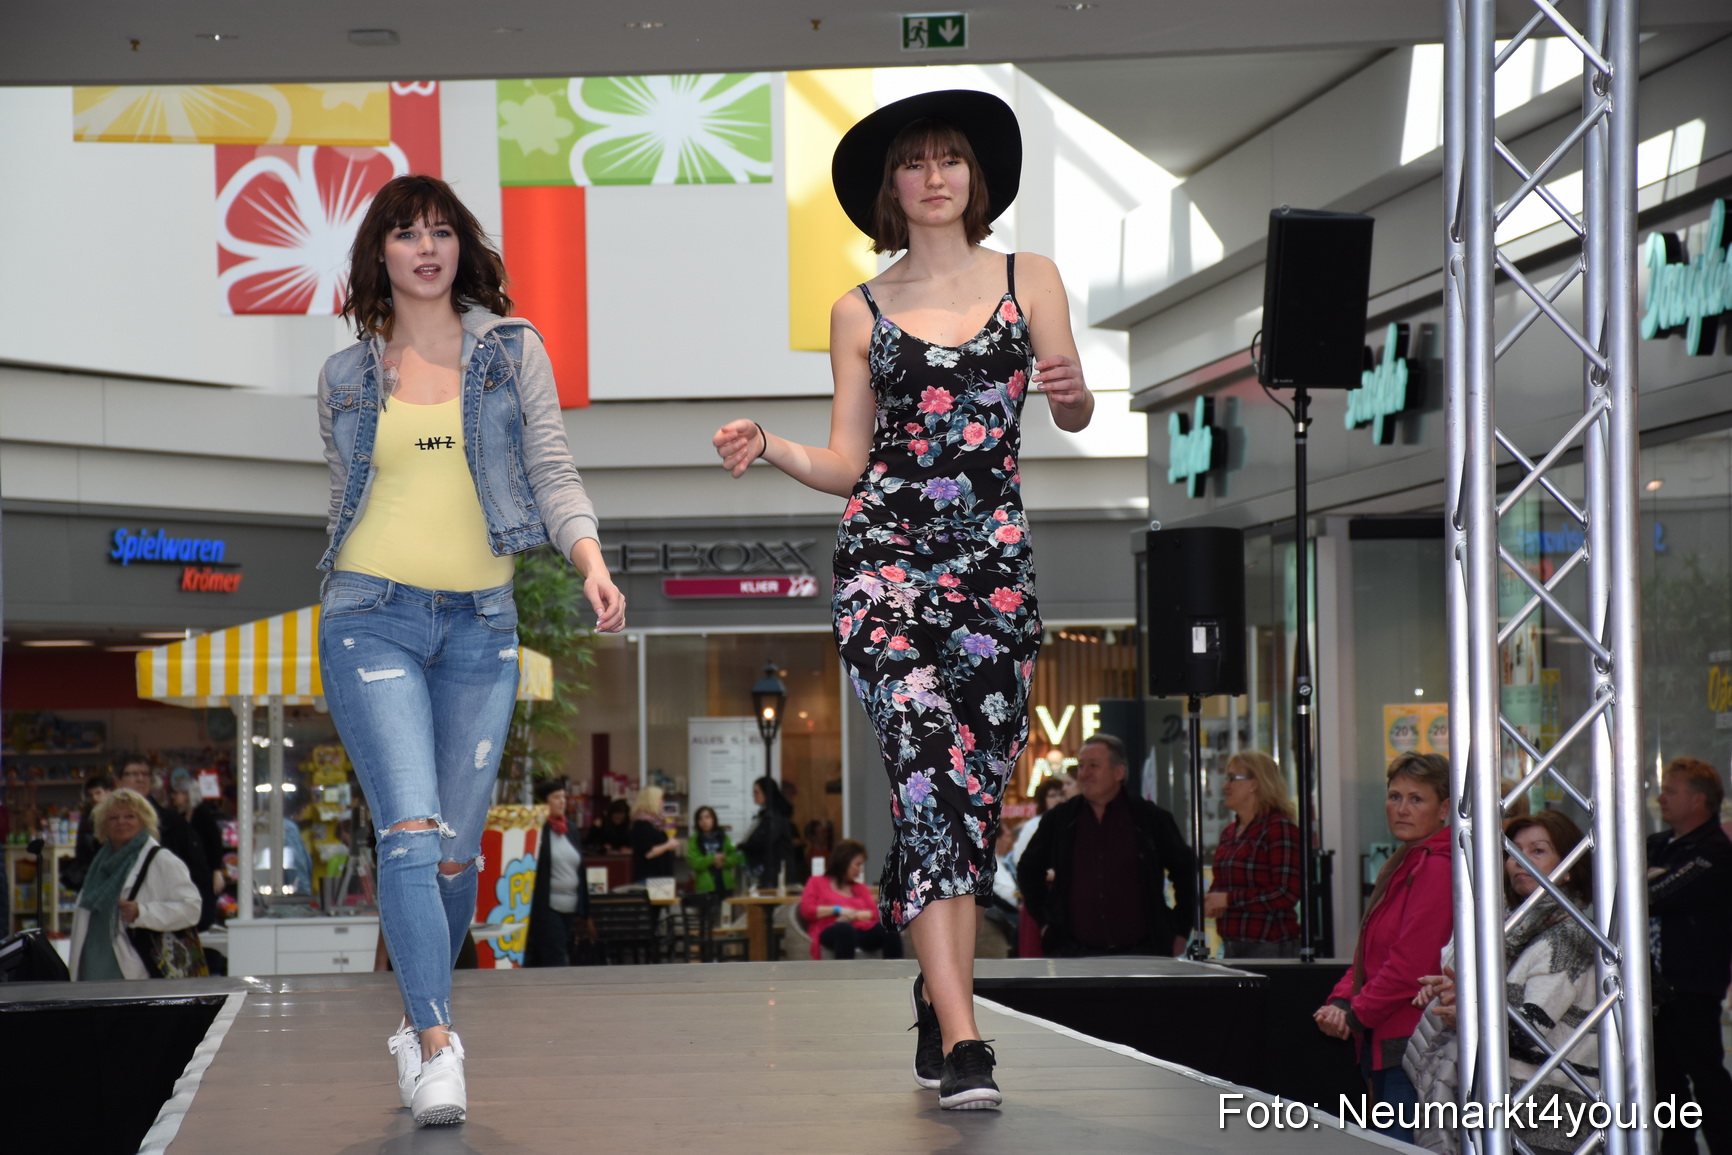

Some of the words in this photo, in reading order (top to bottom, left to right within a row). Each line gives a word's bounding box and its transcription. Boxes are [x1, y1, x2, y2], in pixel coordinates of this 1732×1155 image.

[111, 528, 225, 566] Spielwaren
[618, 538, 817, 573] EBOXX
[181, 566, 243, 592] Krömer
[740, 581, 778, 593] KLIER
[510, 870, 536, 909] PO
